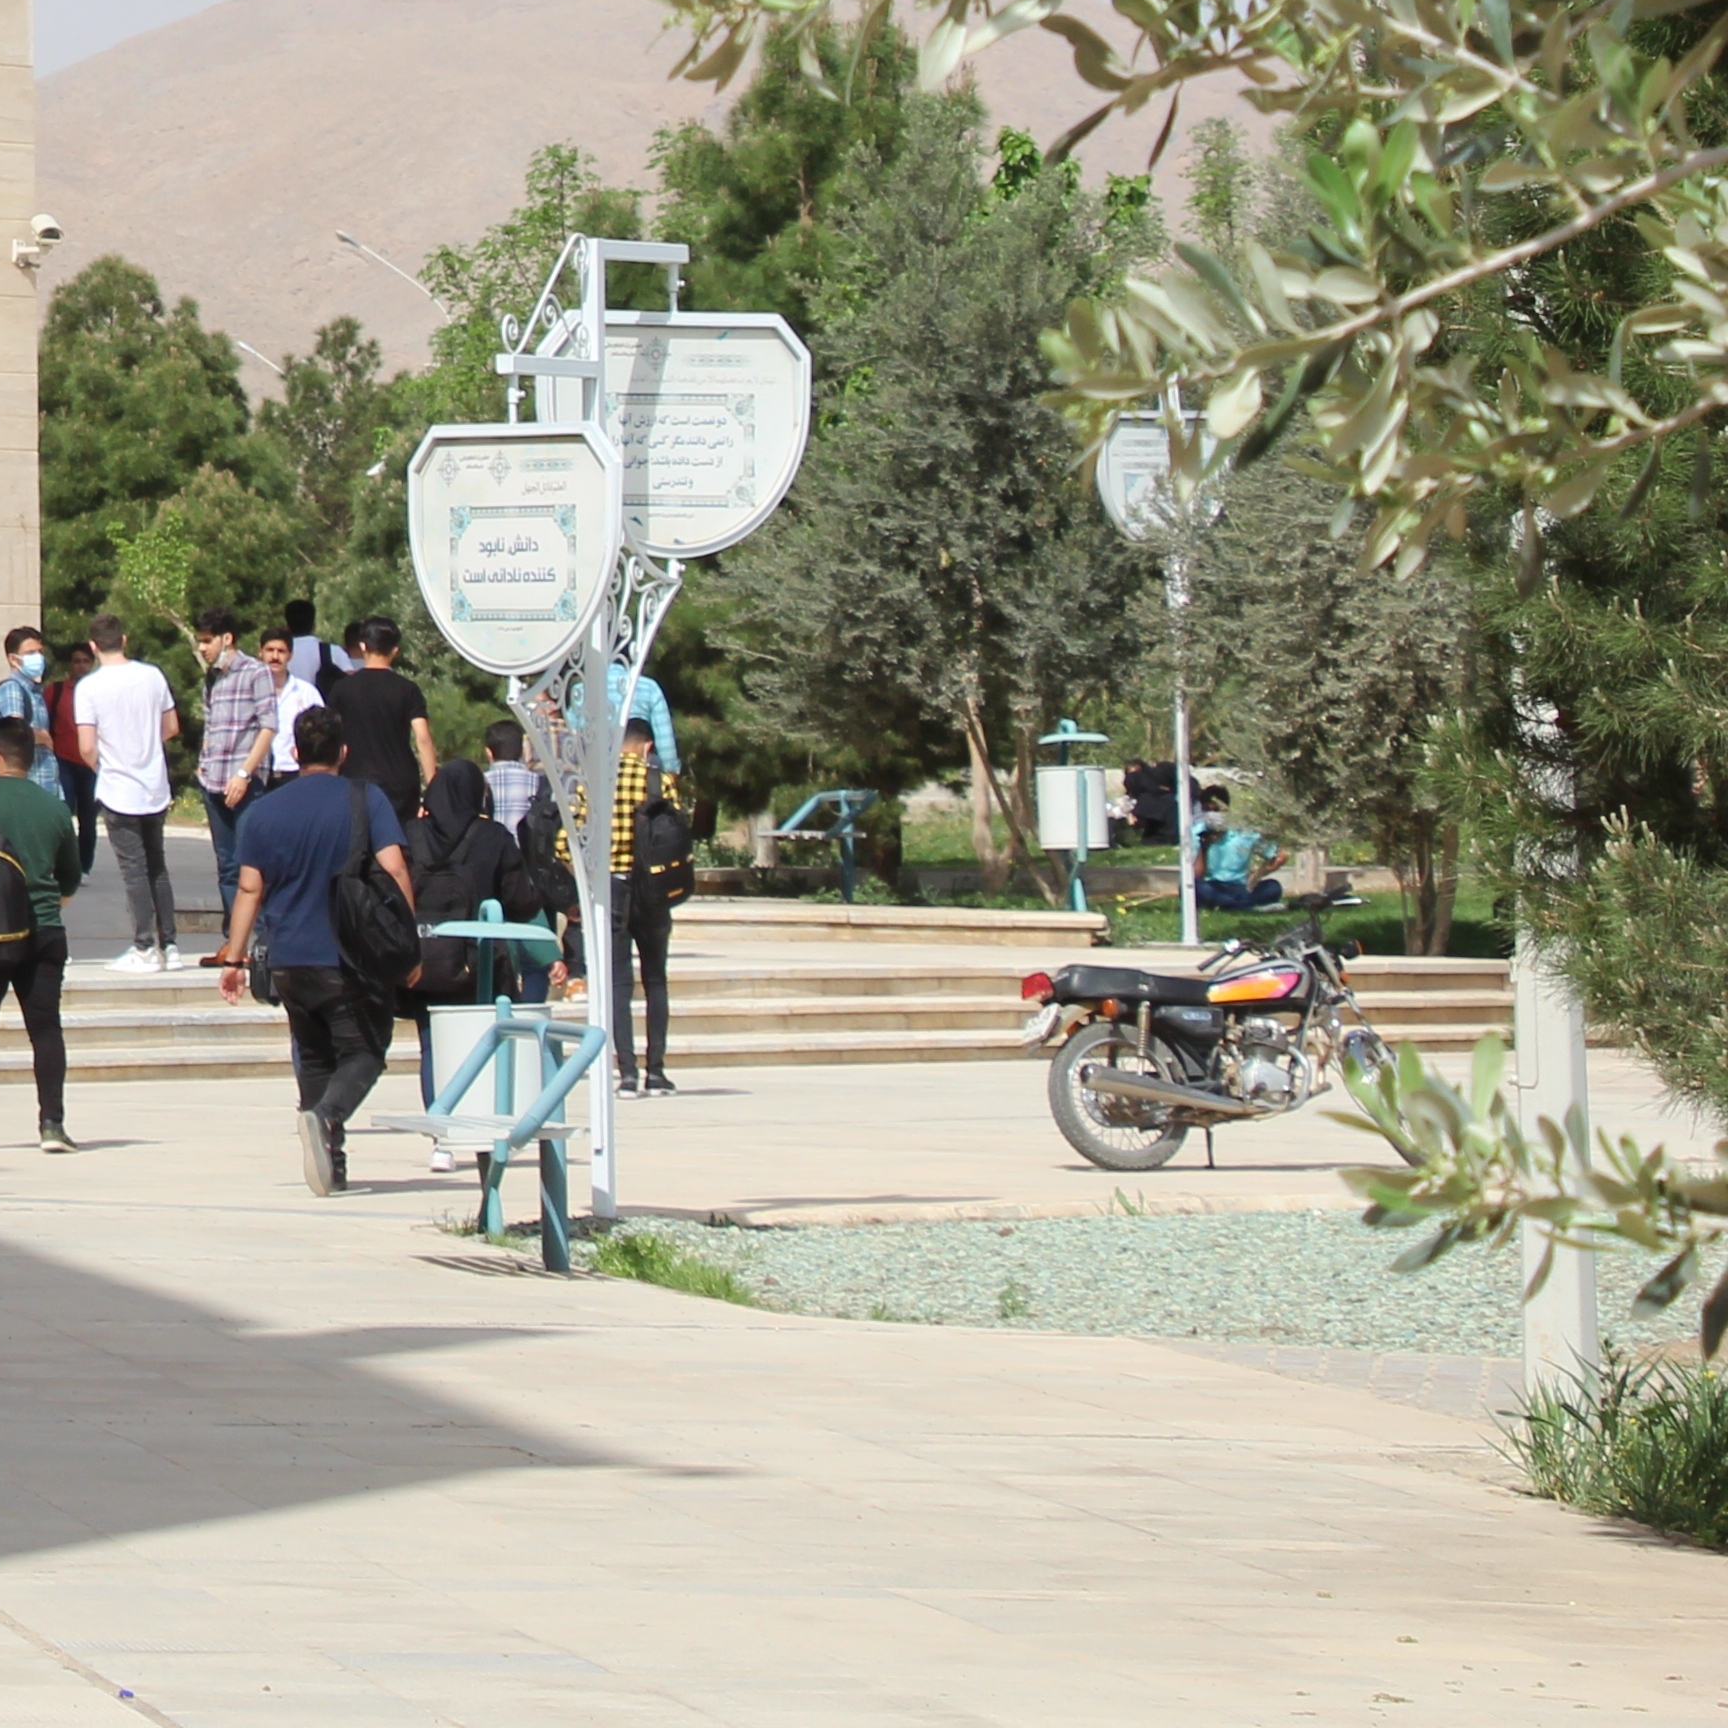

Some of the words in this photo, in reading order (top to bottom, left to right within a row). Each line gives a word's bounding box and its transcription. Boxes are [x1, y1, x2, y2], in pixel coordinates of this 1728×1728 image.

[478, 536, 506, 559] نابود
[507, 533, 540, 556] دانش
[462, 568, 486, 584] است
[487, 567, 522, 583] نادانی
[523, 566, 557, 583] کننده
